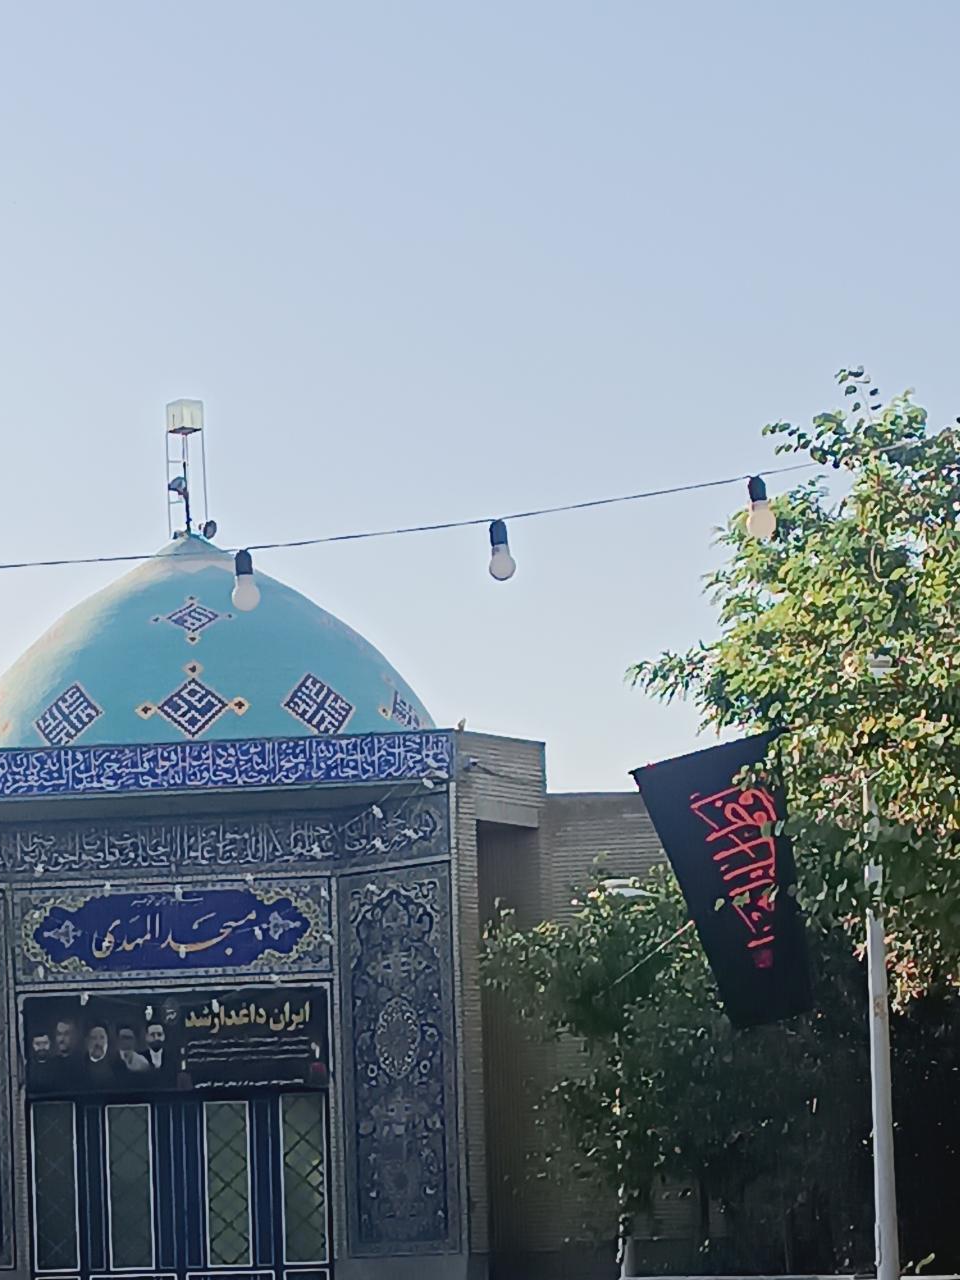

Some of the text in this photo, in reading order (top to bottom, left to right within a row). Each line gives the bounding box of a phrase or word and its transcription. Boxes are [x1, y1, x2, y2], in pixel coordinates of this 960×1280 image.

[91, 909, 257, 958] مسجد المهدی
[185, 1006, 212, 1027] شد
[210, 1002, 266, 1034] داغدار
[269, 1000, 310, 1031] ایران
